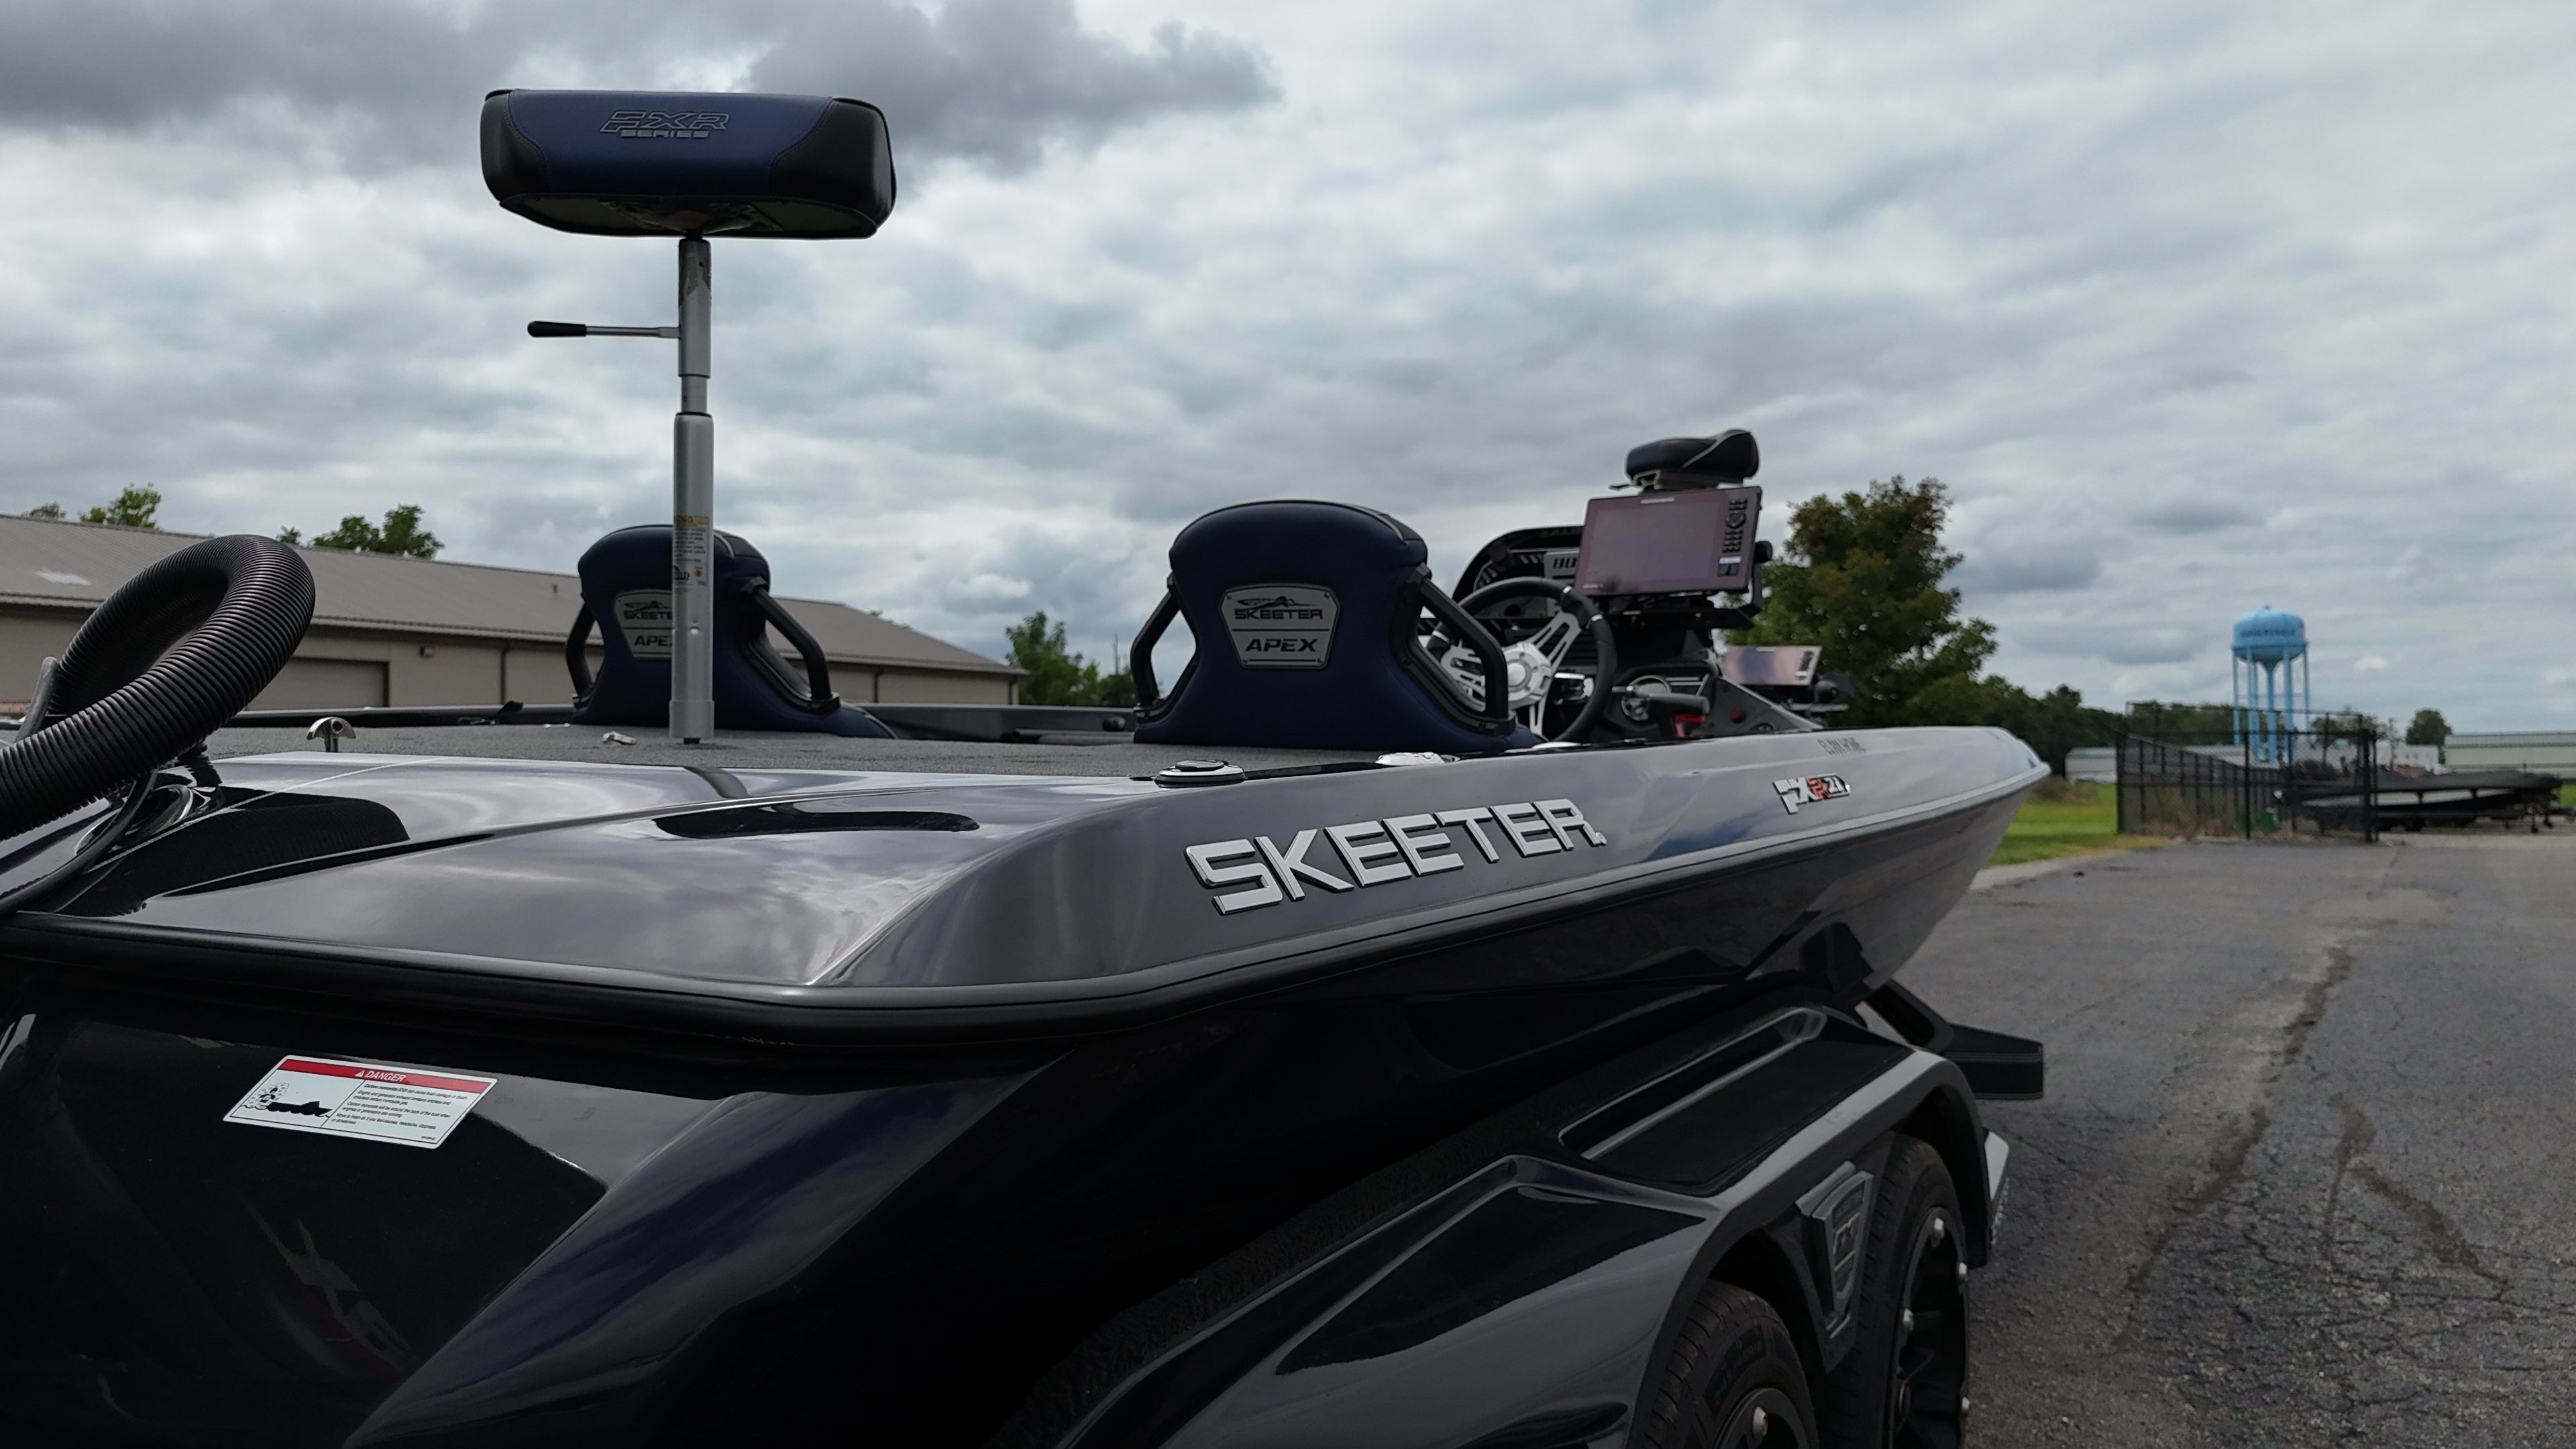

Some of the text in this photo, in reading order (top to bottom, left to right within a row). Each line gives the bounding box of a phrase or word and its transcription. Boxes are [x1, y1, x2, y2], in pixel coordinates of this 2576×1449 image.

[600, 111, 730, 133] FXR
[621, 129, 710, 138] SERIES
[624, 611, 672, 620] SKEETE
[1234, 608, 1324, 620] SKEETER
[634, 635, 672, 647] APE
[1245, 639, 1318, 652] APEX
[1184, 798, 1602, 915] SKEETER
[364, 1071, 406, 1081] DANGER
